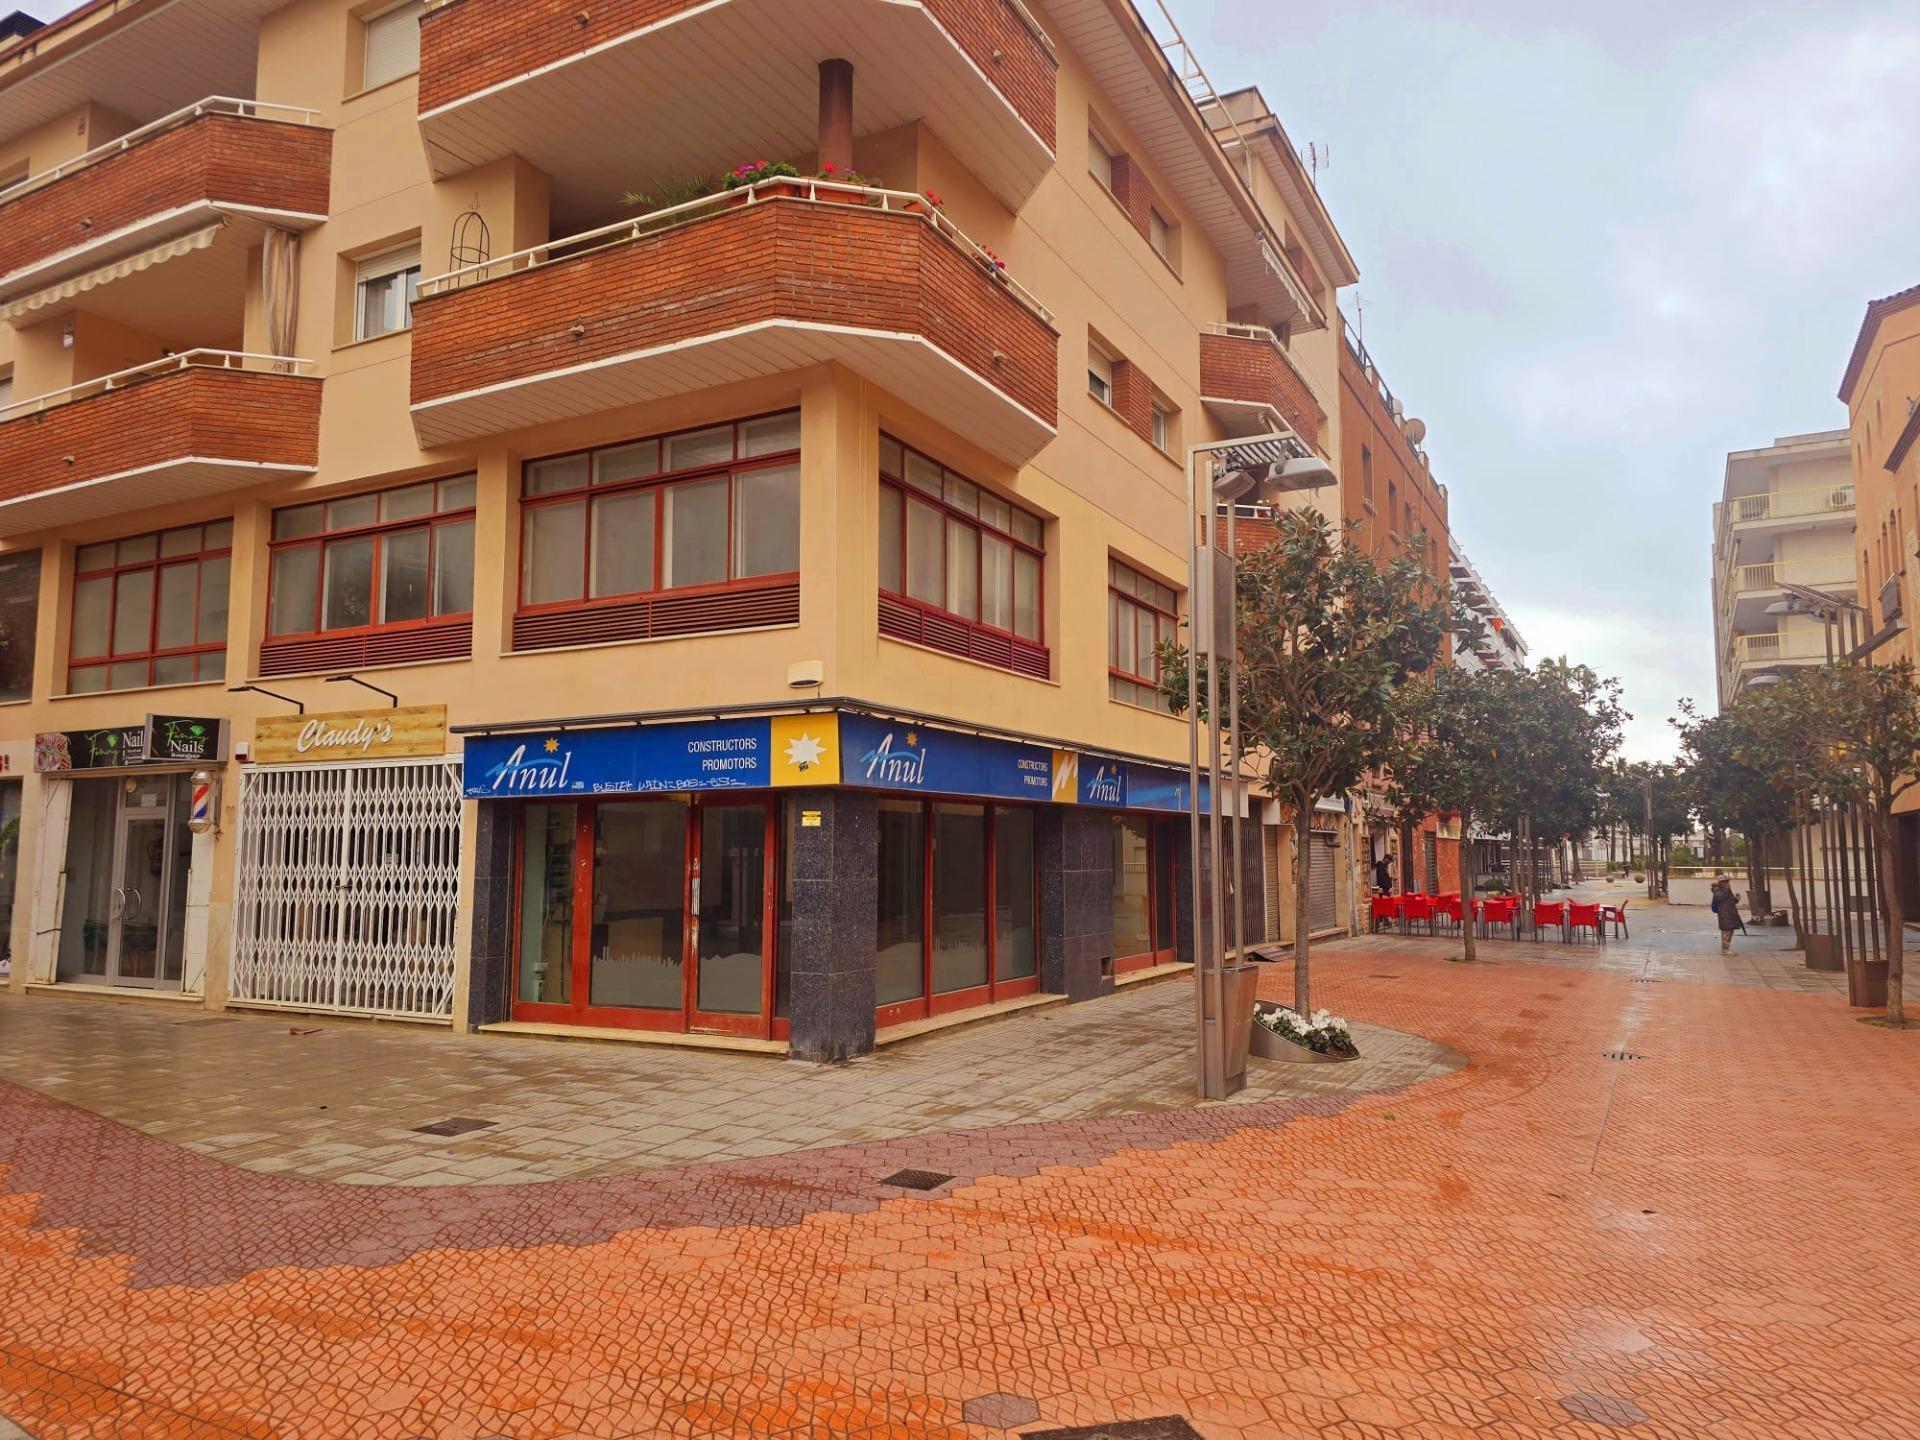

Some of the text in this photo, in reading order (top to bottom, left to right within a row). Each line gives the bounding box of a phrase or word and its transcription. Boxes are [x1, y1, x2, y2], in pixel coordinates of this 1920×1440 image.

[122, 730, 144, 748] Nail
[296, 719, 393, 753] Claudy's
[170, 740, 204, 753] Nails
[687, 737, 757, 753] CONSTRUCTORS
[702, 757, 757, 772] PROMOTORS
[866, 732, 927, 785] Anul
[1017, 759, 1048, 773] CONSTRUCTORS
[491, 744, 572, 791] Anul
[1023, 775, 1048, 787] PROMOTORS
[1089, 765, 1121, 802] Anul
